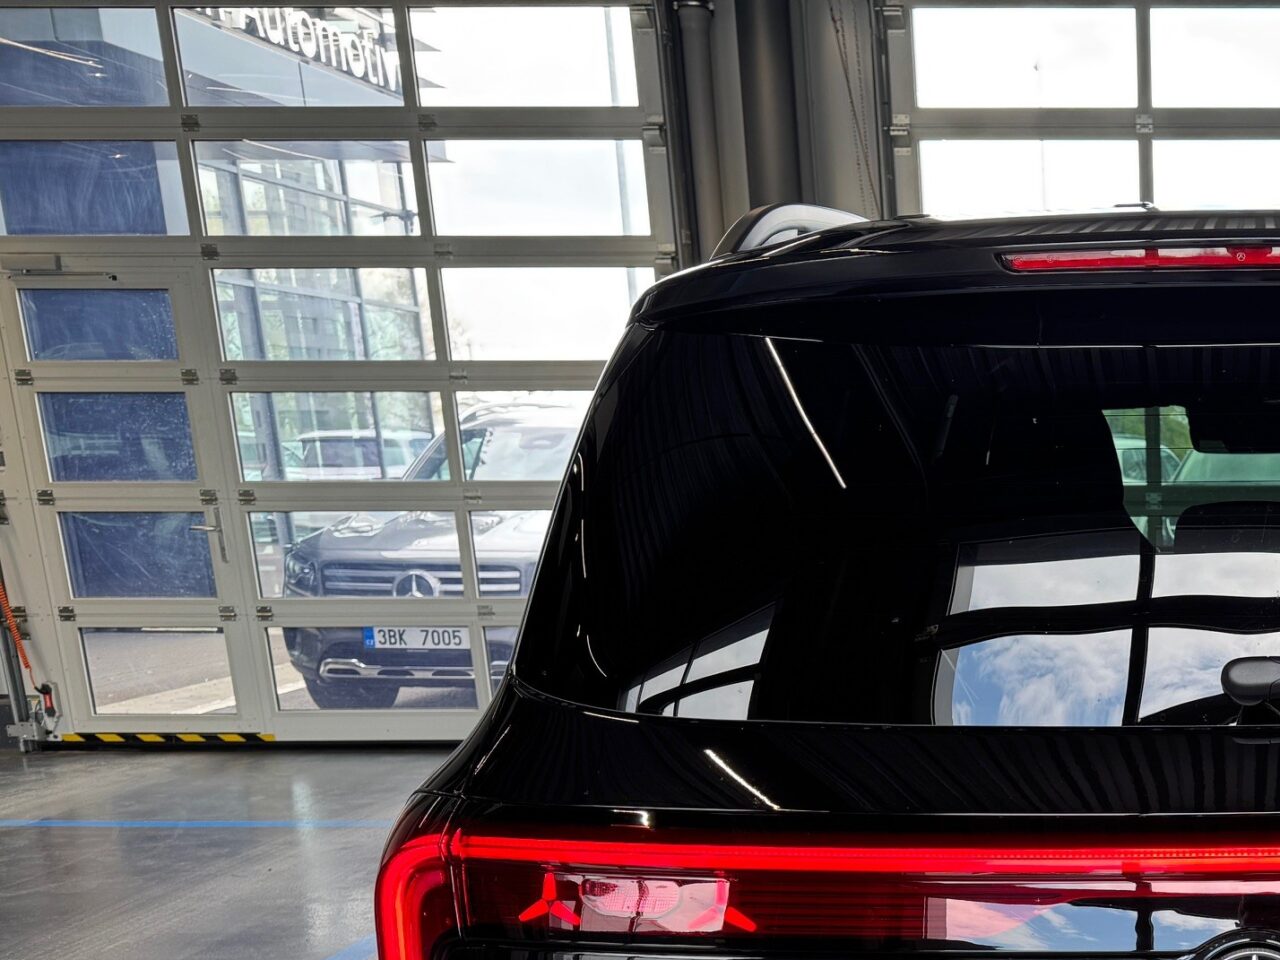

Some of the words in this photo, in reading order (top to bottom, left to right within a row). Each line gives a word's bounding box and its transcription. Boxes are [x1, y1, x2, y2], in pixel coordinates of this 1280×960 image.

[238, 8, 402, 91] Automotiv
[377, 629, 408, 646] 3BK
[420, 629, 462, 646] 7005
